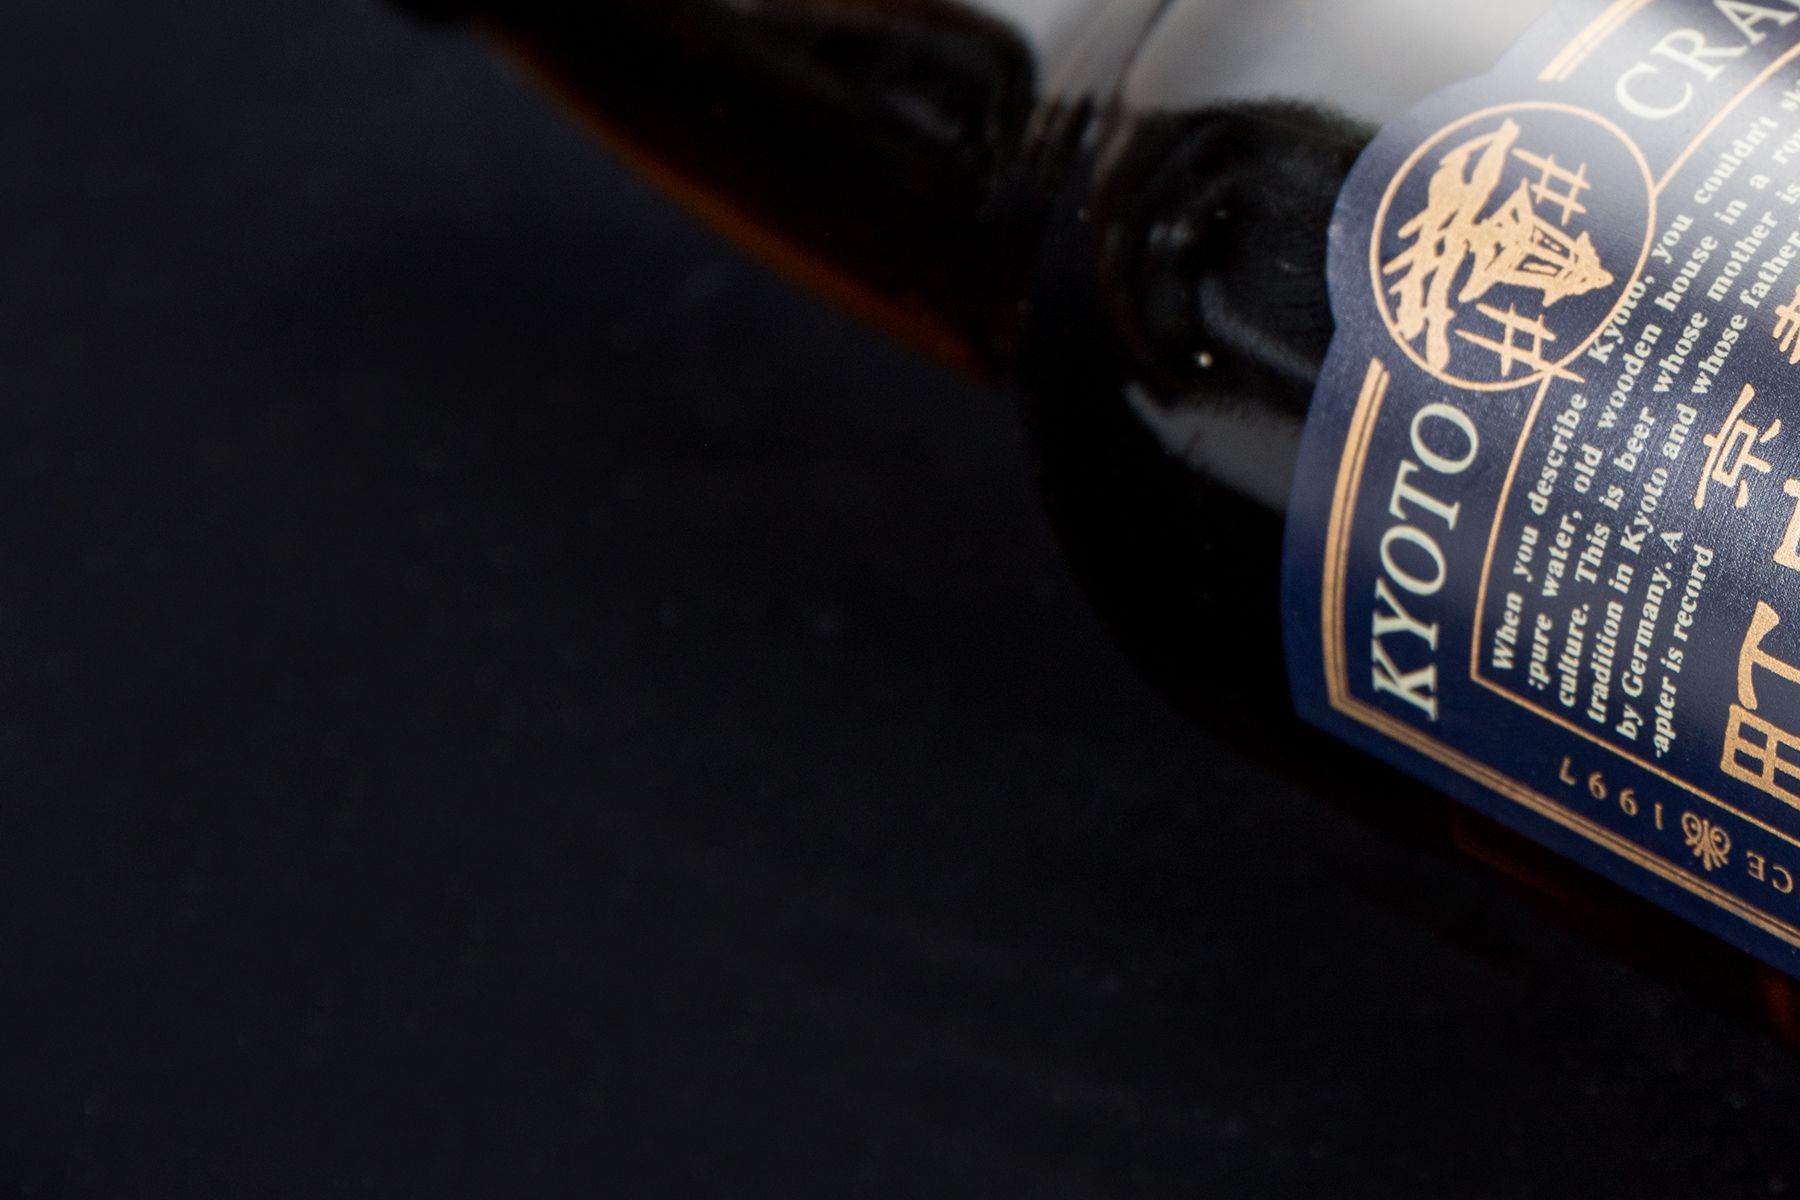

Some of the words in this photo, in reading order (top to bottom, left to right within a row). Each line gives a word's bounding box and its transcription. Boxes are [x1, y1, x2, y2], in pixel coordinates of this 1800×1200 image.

[1492, 592, 1522, 669] When
[1513, 526, 1540, 581] you
[1527, 393, 1588, 516] describe
[1587, 274, 1655, 364] Kyoto,
[1650, 213, 1694, 265] you
[1693, 115, 1780, 204] couldn't
[1542, 509, 1583, 597] water,
[1573, 443, 1602, 494] old
[1597, 323, 1663, 428] wooden
[1654, 235, 1719, 312] house
[1714, 199, 1748, 227] in
[1749, 172, 1771, 191] a
[1691, 313, 1748, 394] whose
[1559, 602, 1591, 707] culture.
[1575, 522, 1611, 584] This
[1599, 483, 1625, 511] is
[1613, 406, 1656, 473] beer
[1653, 311, 1709, 393] whose
[1707, 210, 1779, 302] mother
[1662, 403, 1697, 461] and
[1371, 402, 1480, 723] KYOTO
[1620, 467, 1668, 555] Kyoto
[1659, 530, 1684, 554] A
[1608, 562, 1634, 596] in
[1621, 561, 1673, 698] Germany.
[1660, 644, 1684, 673] is
[1672, 543, 1713, 642] record
[1586, 599, 1624, 724] tradition
[1616, 703, 1644, 741] by
[1558, 756, 1664, 831] 1997
